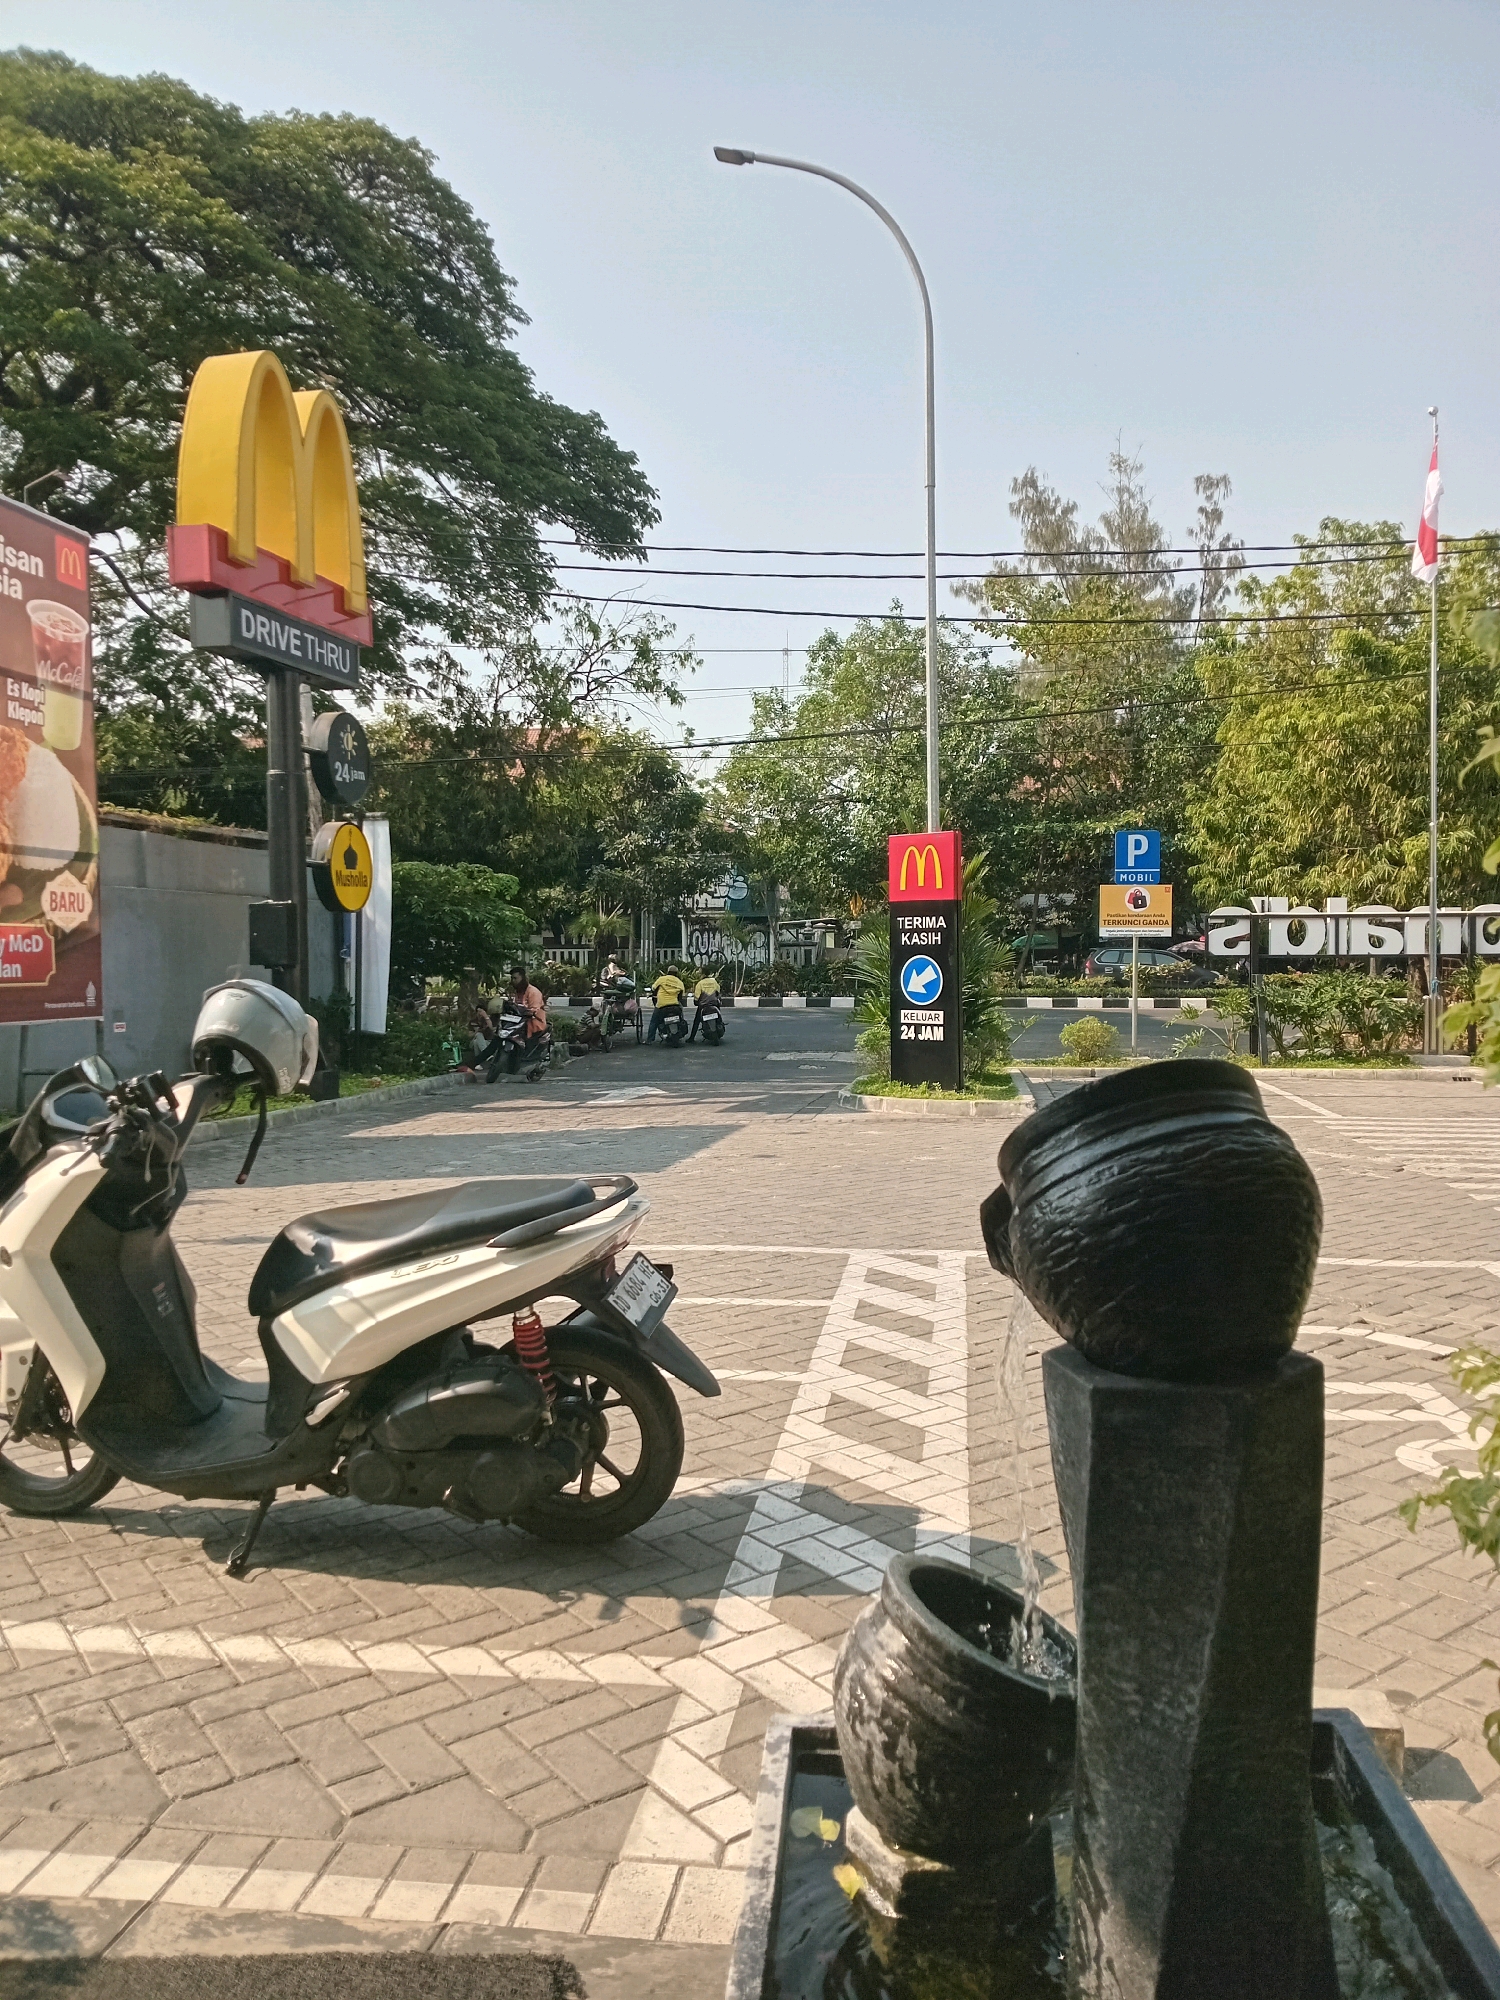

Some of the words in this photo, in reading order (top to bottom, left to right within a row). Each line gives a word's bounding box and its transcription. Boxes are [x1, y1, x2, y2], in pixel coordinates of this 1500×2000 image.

[241, 608, 302, 657] DRIVE
[303, 633, 350, 673] THRU
[6, 677, 20, 698] Es
[21, 682, 45, 706] Kopi
[7, 700, 45, 726] Klepon
[334, 761, 350, 782] 24
[350, 766, 366, 782] jam
[1127, 834, 1149, 867] P
[335, 869, 369, 888] Musholla
[1119, 873, 1154, 882] MOBIL
[49, 890, 85, 913] BARU
[896, 915, 947, 929] TERIMA
[9, 934, 44, 953] McD
[901, 931, 942, 945] KASIH
[903, 1012, 941, 1022] KELUAR
[900, 1025, 916, 1040] 24
[918, 1025, 944, 1041] JAM
[612, 1295, 631, 1315] AD
[623, 1273, 647, 1301] 6684
[637, 1260, 656, 1280] HE
